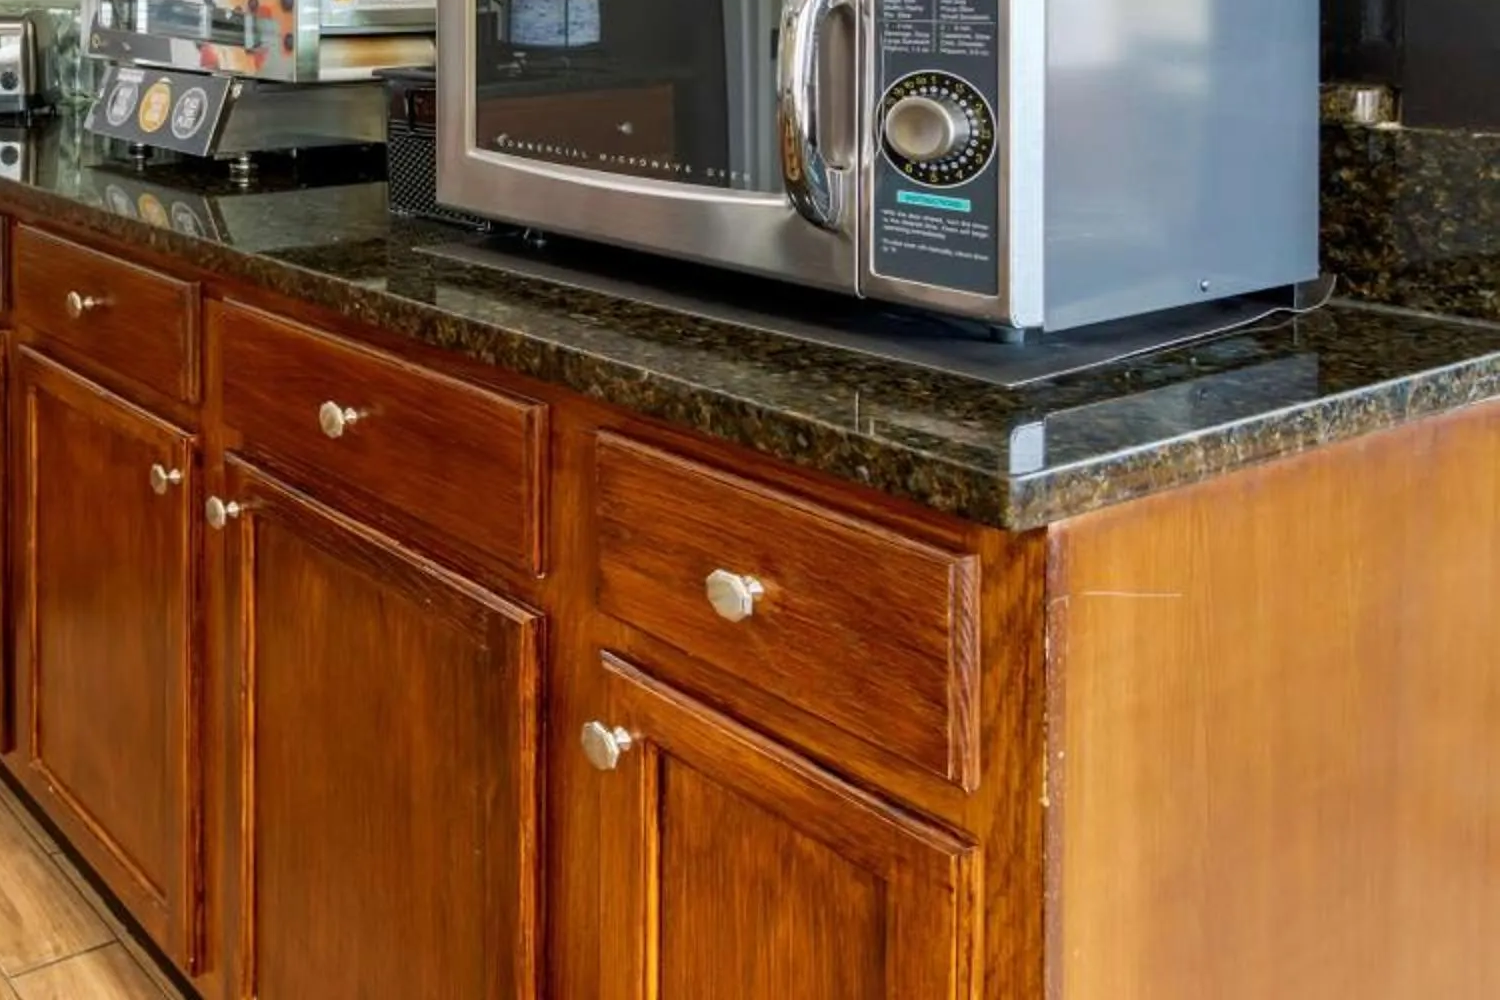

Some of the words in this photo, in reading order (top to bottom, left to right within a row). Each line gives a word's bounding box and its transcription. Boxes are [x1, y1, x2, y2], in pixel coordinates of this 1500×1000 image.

[498, 137, 588, 160] COMMERCIAL
[600, 153, 692, 174] MICROWAVE
[706, 167, 750, 182] OVEN
